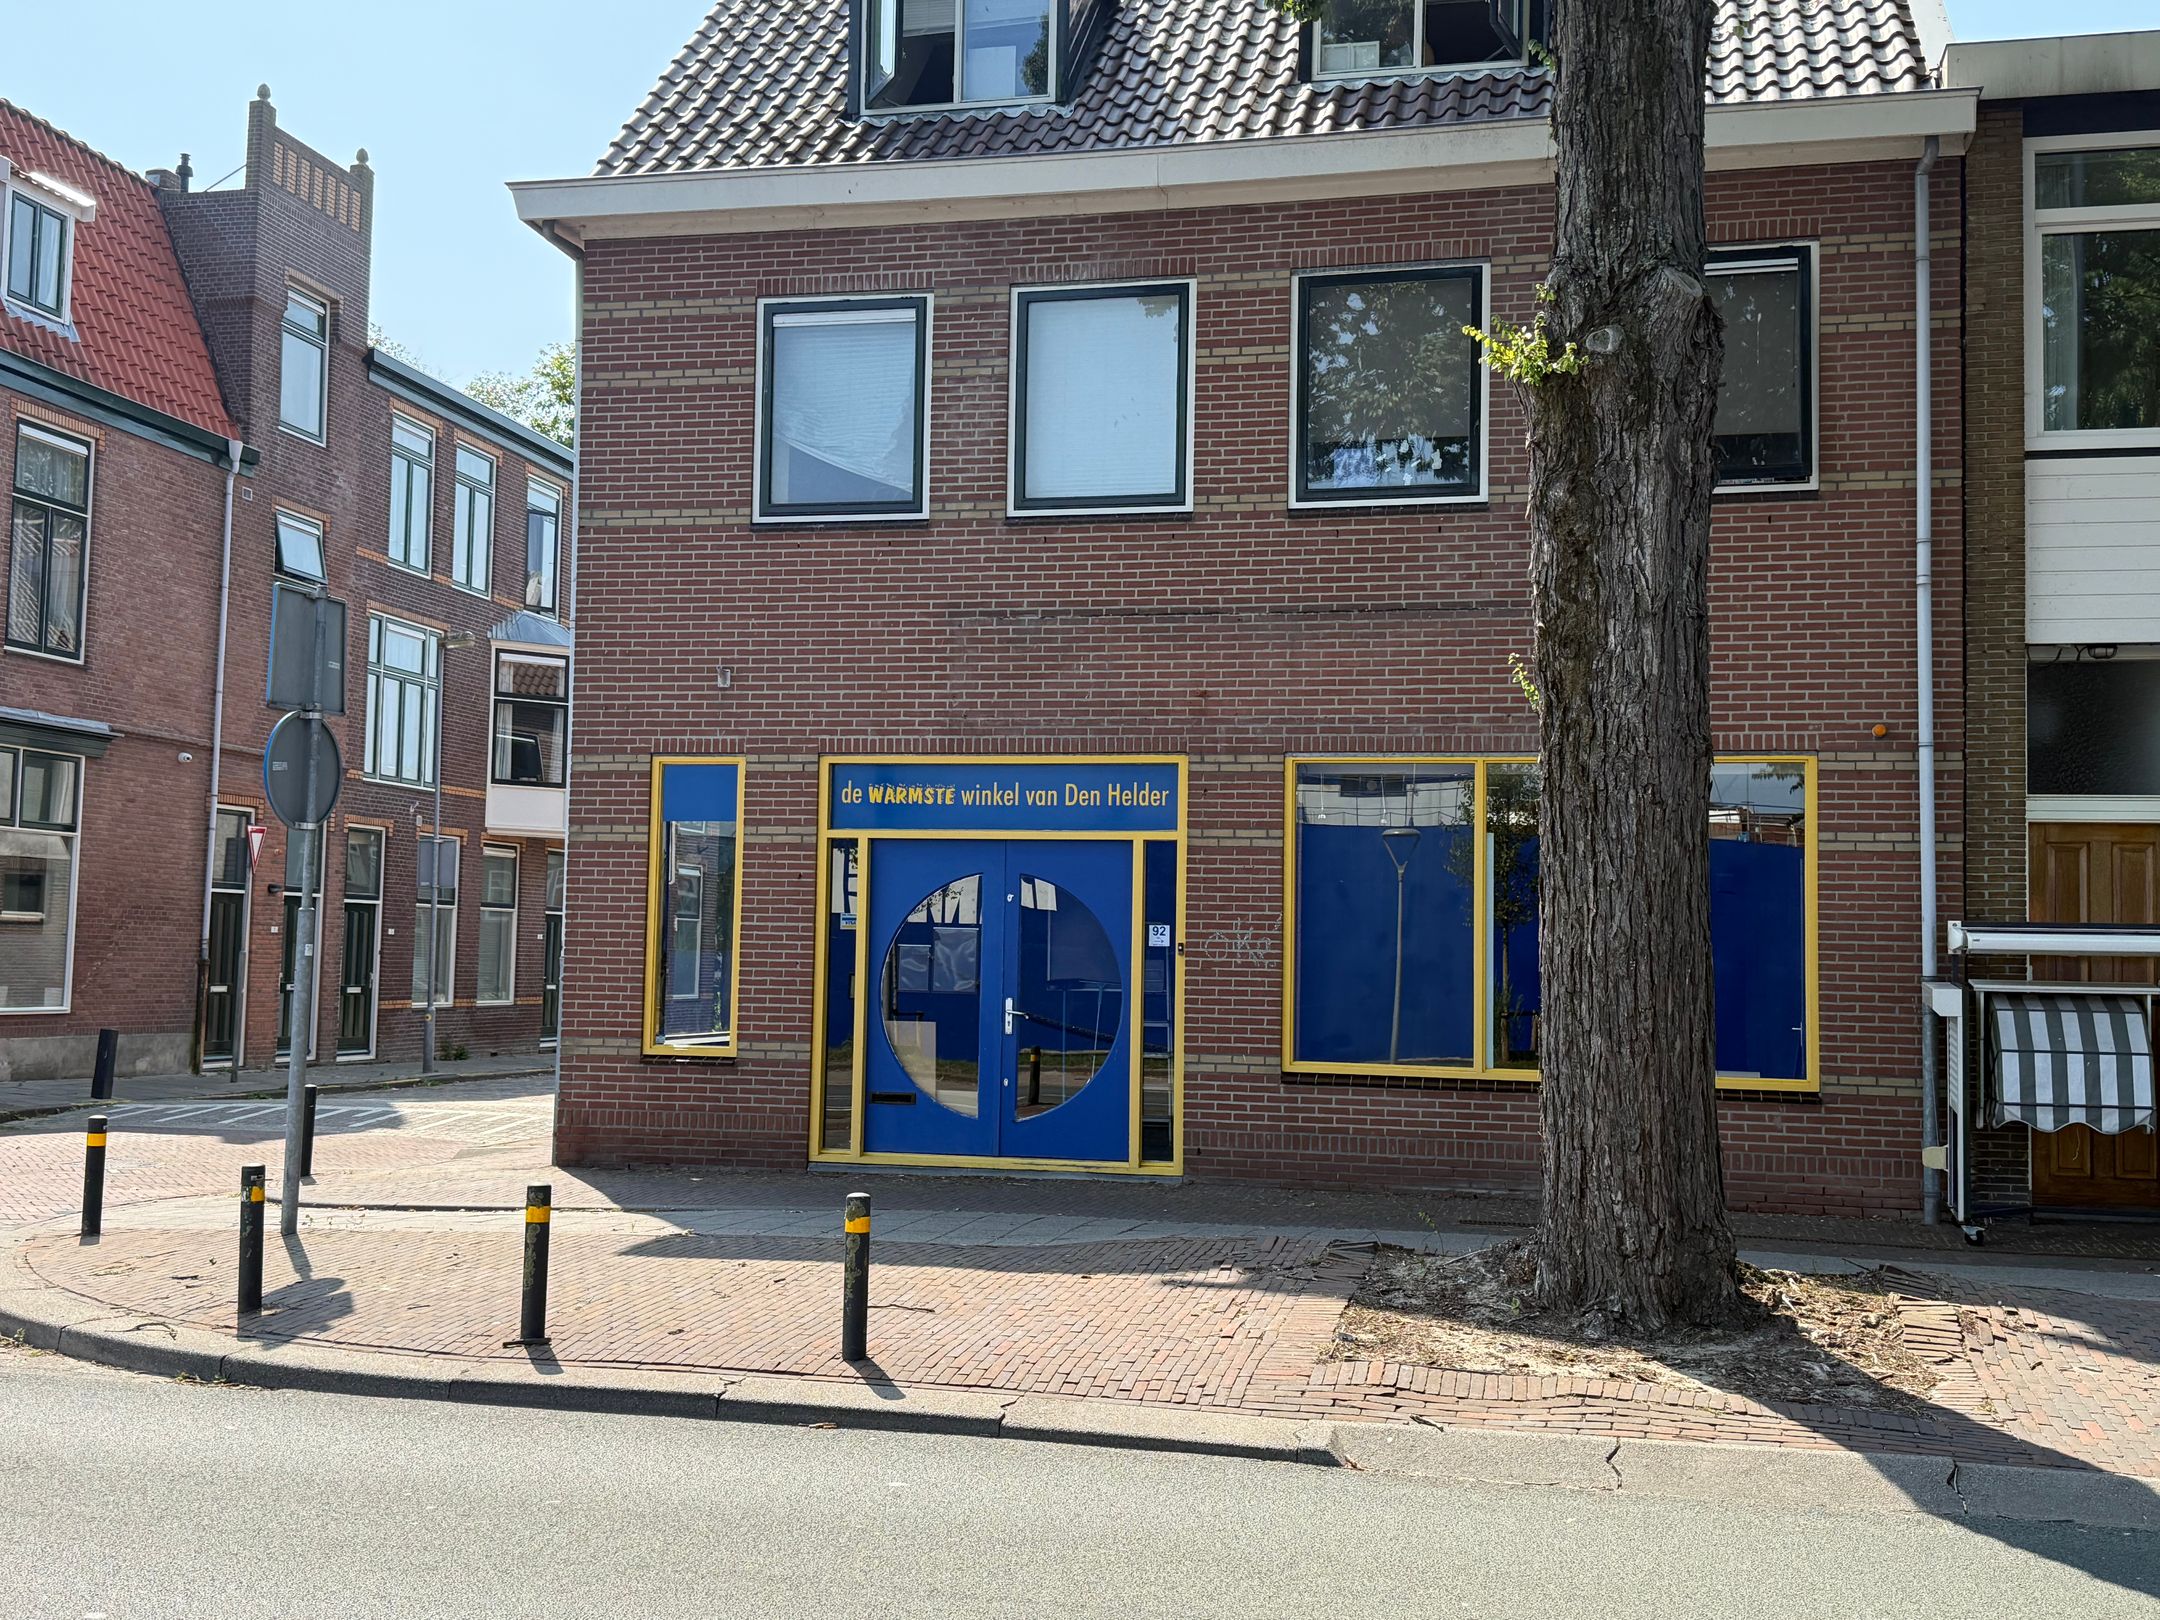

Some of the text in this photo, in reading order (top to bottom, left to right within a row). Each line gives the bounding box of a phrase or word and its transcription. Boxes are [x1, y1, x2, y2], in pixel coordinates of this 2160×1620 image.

[841, 780, 1169, 806] de WARMSTE winkel van Den Helder
[1152, 926, 1167, 937] 92
